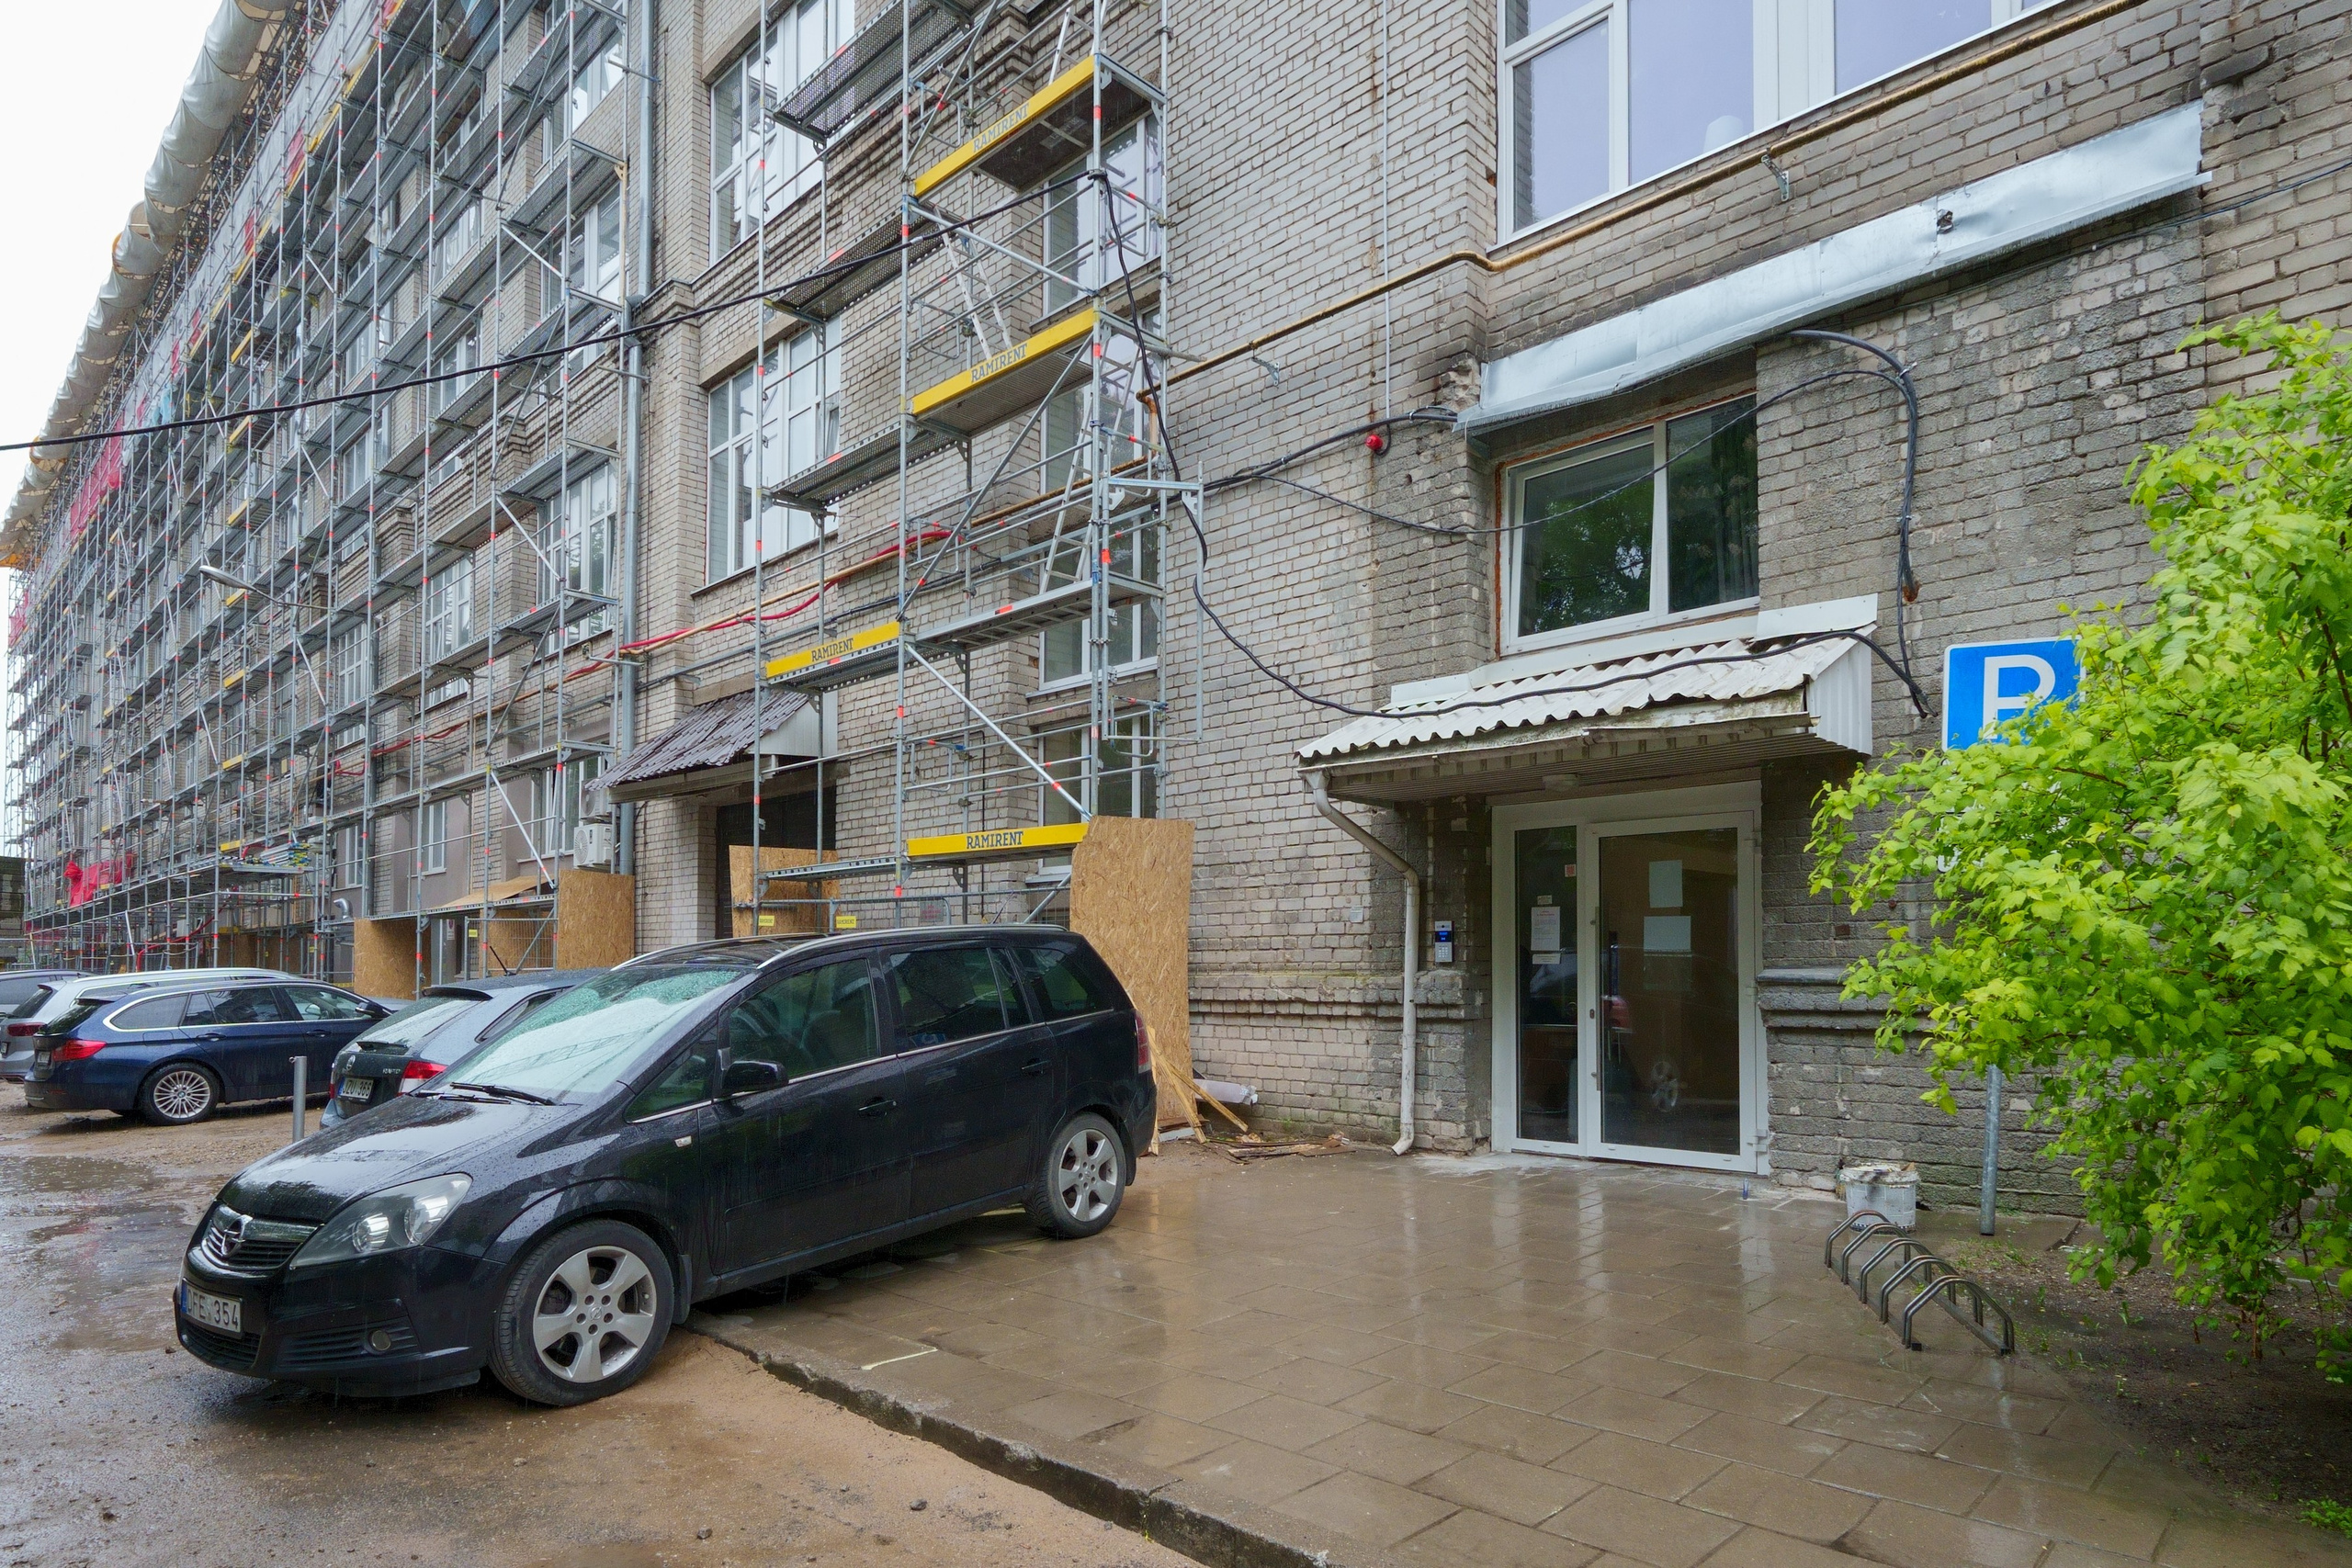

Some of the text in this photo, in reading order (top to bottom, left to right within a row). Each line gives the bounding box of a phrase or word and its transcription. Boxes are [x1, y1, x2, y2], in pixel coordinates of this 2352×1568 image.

[973, 103, 1029, 152] RAMIRENT
[971, 343, 1027, 383] RAMIRENT
[811, 637, 854, 662] RAMIRENT
[1983, 654, 2055, 739] P
[967, 830, 1023, 850] RAMIRENT
[214, 1299, 239, 1329] 354
